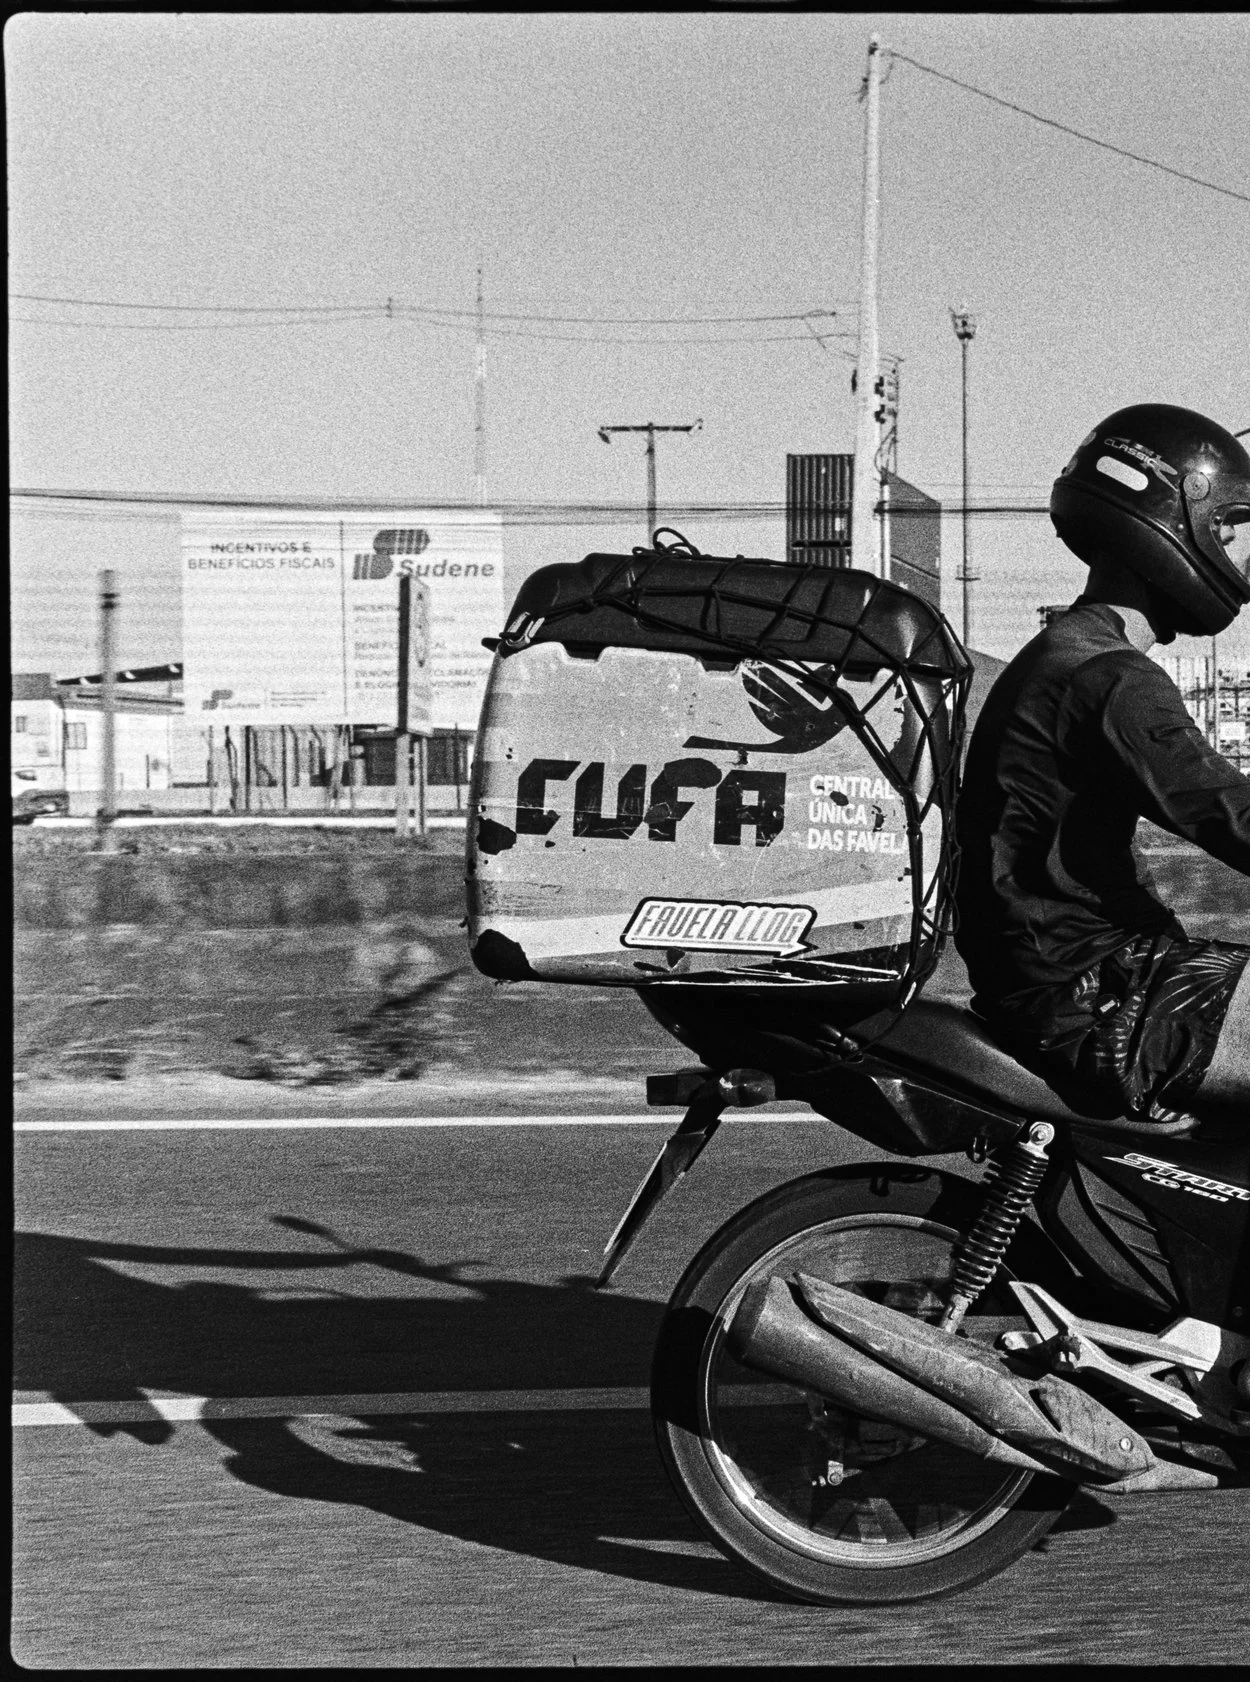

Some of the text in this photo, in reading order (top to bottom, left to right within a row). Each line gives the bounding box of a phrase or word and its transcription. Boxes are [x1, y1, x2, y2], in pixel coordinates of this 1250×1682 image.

[211, 541, 311, 553] INCENTIVOS E
[280, 556, 335, 569] FISCAIS
[399, 559, 494, 577] Sudene
[810, 775, 895, 799] CENTRAL
[515, 757, 786, 847] CUFA
[809, 798, 867, 825] ÚNICA
[807, 828, 843, 852] DAS
[634, 905, 737, 939] FAVELA
[1141, 1172, 1181, 1189] CG
